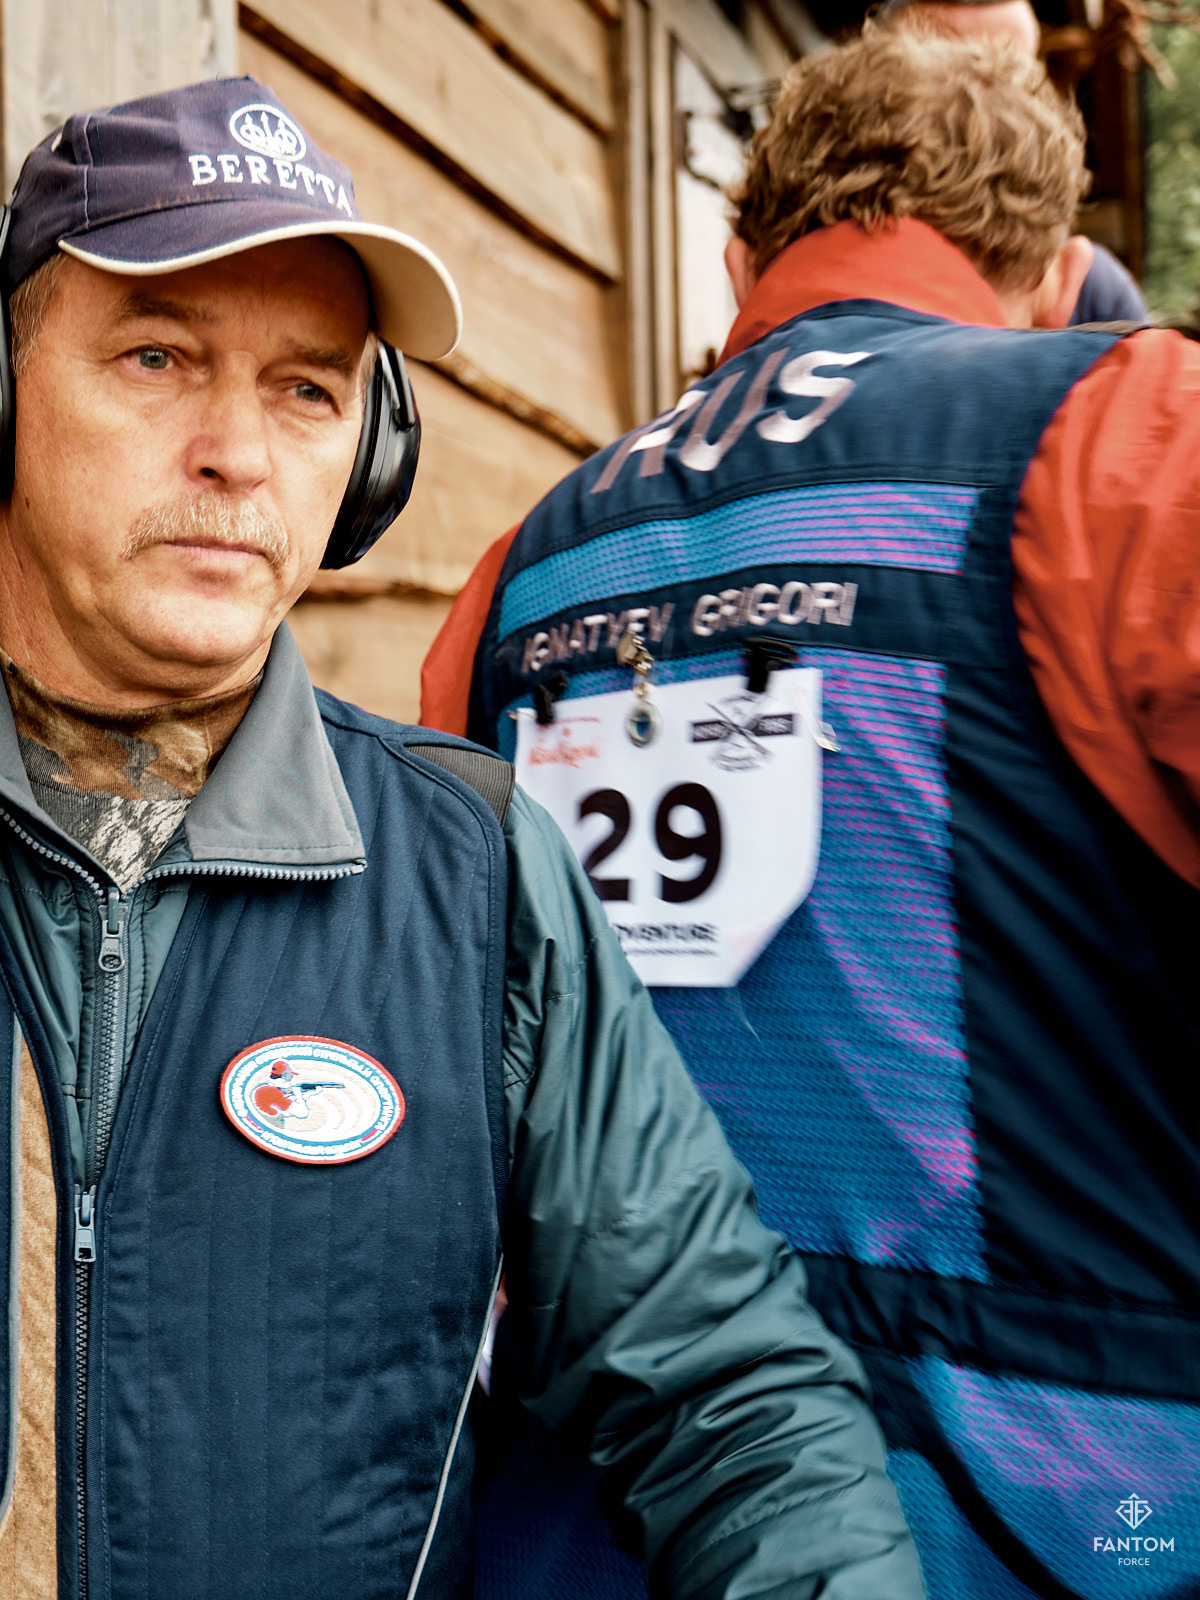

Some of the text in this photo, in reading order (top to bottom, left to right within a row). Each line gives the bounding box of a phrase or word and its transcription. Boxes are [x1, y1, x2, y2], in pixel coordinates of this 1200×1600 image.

[188, 154, 353, 218] BERETTA
[590, 346, 873, 494] RUS
[692, 580, 859, 637] GRIGORI
[578, 782, 723, 903] 29
